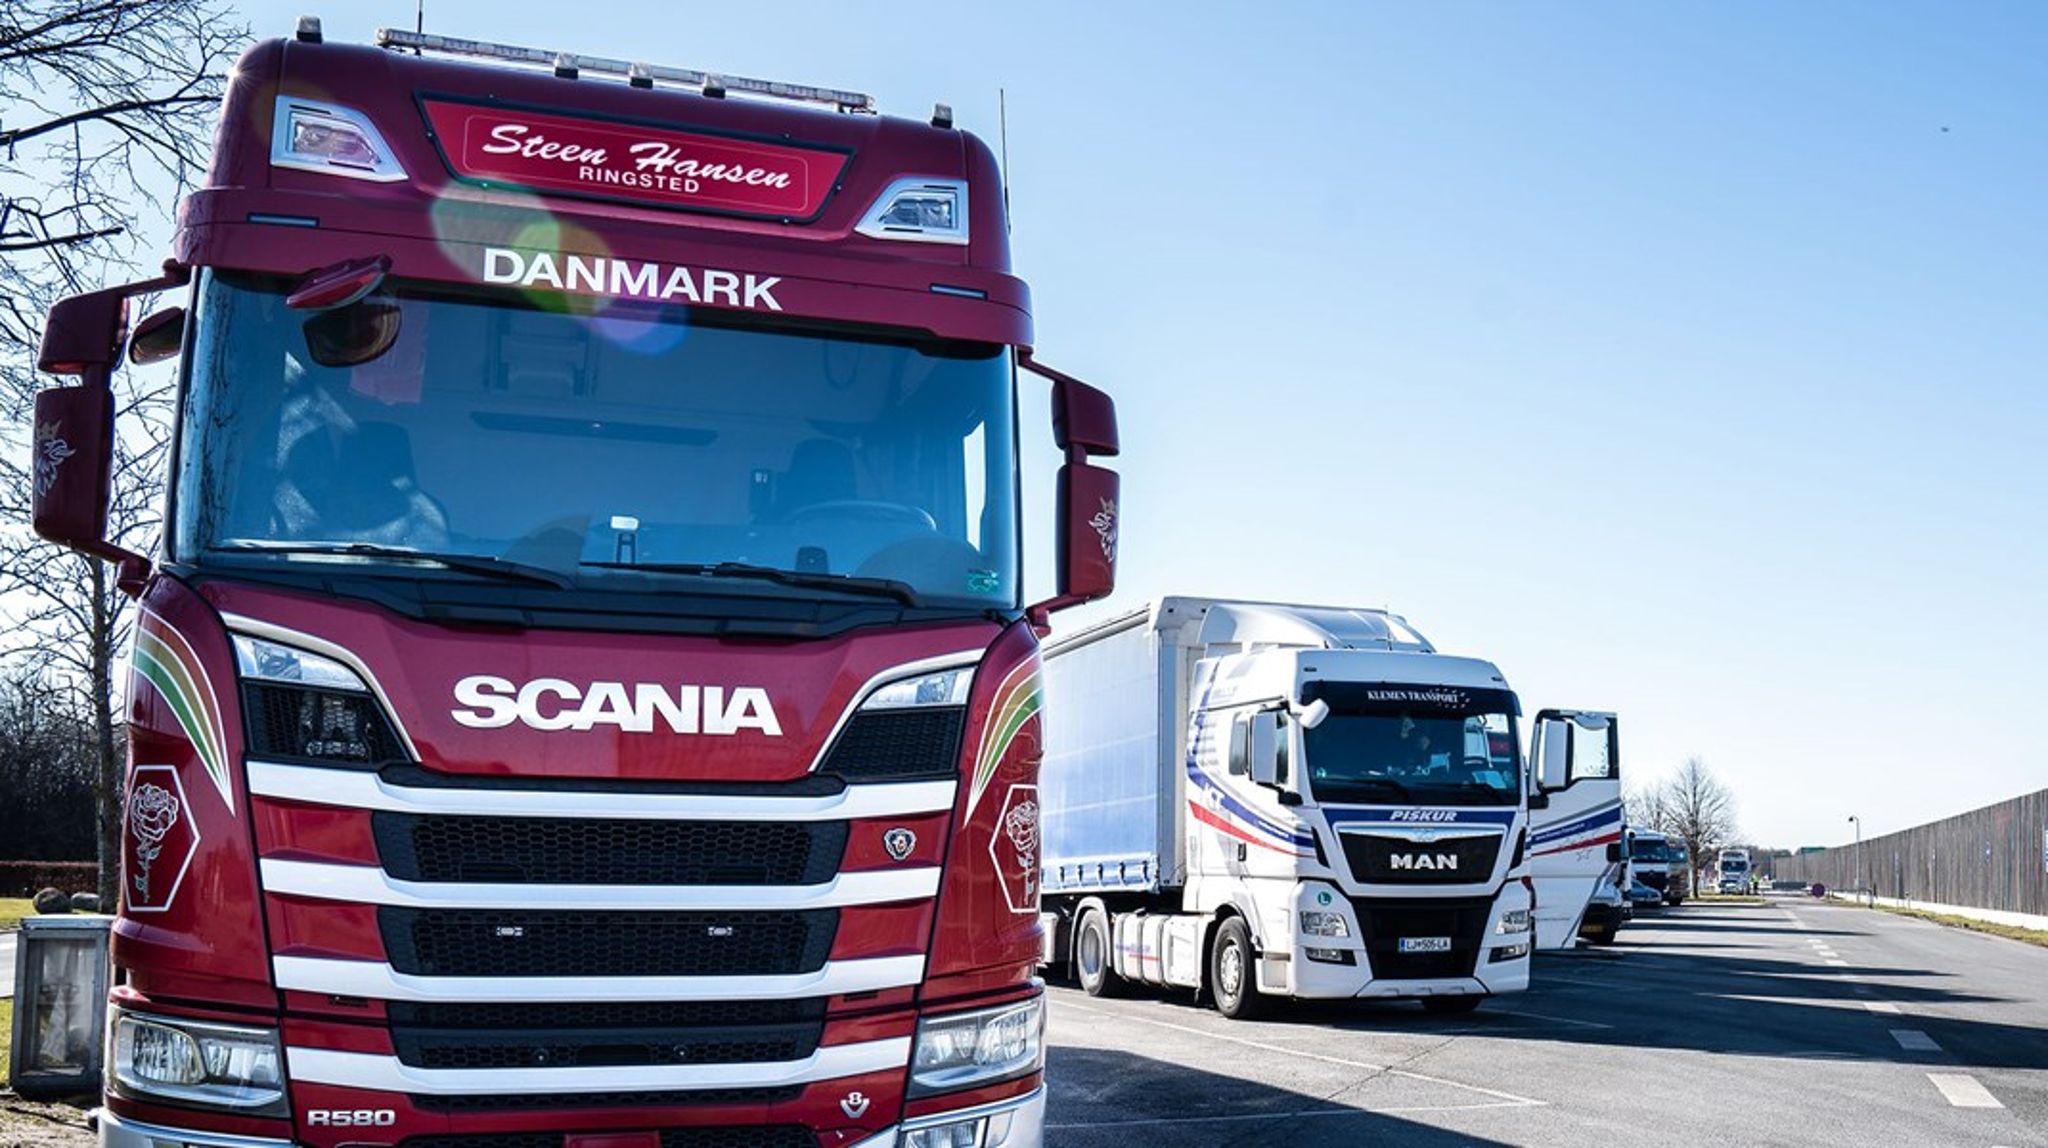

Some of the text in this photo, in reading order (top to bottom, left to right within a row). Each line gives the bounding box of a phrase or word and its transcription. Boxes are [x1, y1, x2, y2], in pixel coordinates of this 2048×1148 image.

[482, 124, 791, 189] Steen Hansen
[579, 165, 700, 194] RINGSTED
[482, 247, 783, 311] DANMARK
[450, 675, 783, 736] SCANIA
[1367, 690, 1458, 703] KLEMEN TRANSPORT
[1389, 810, 1458, 822] PISKUR
[1390, 853, 1458, 870] MAN
[307, 1109, 396, 1127] R580
